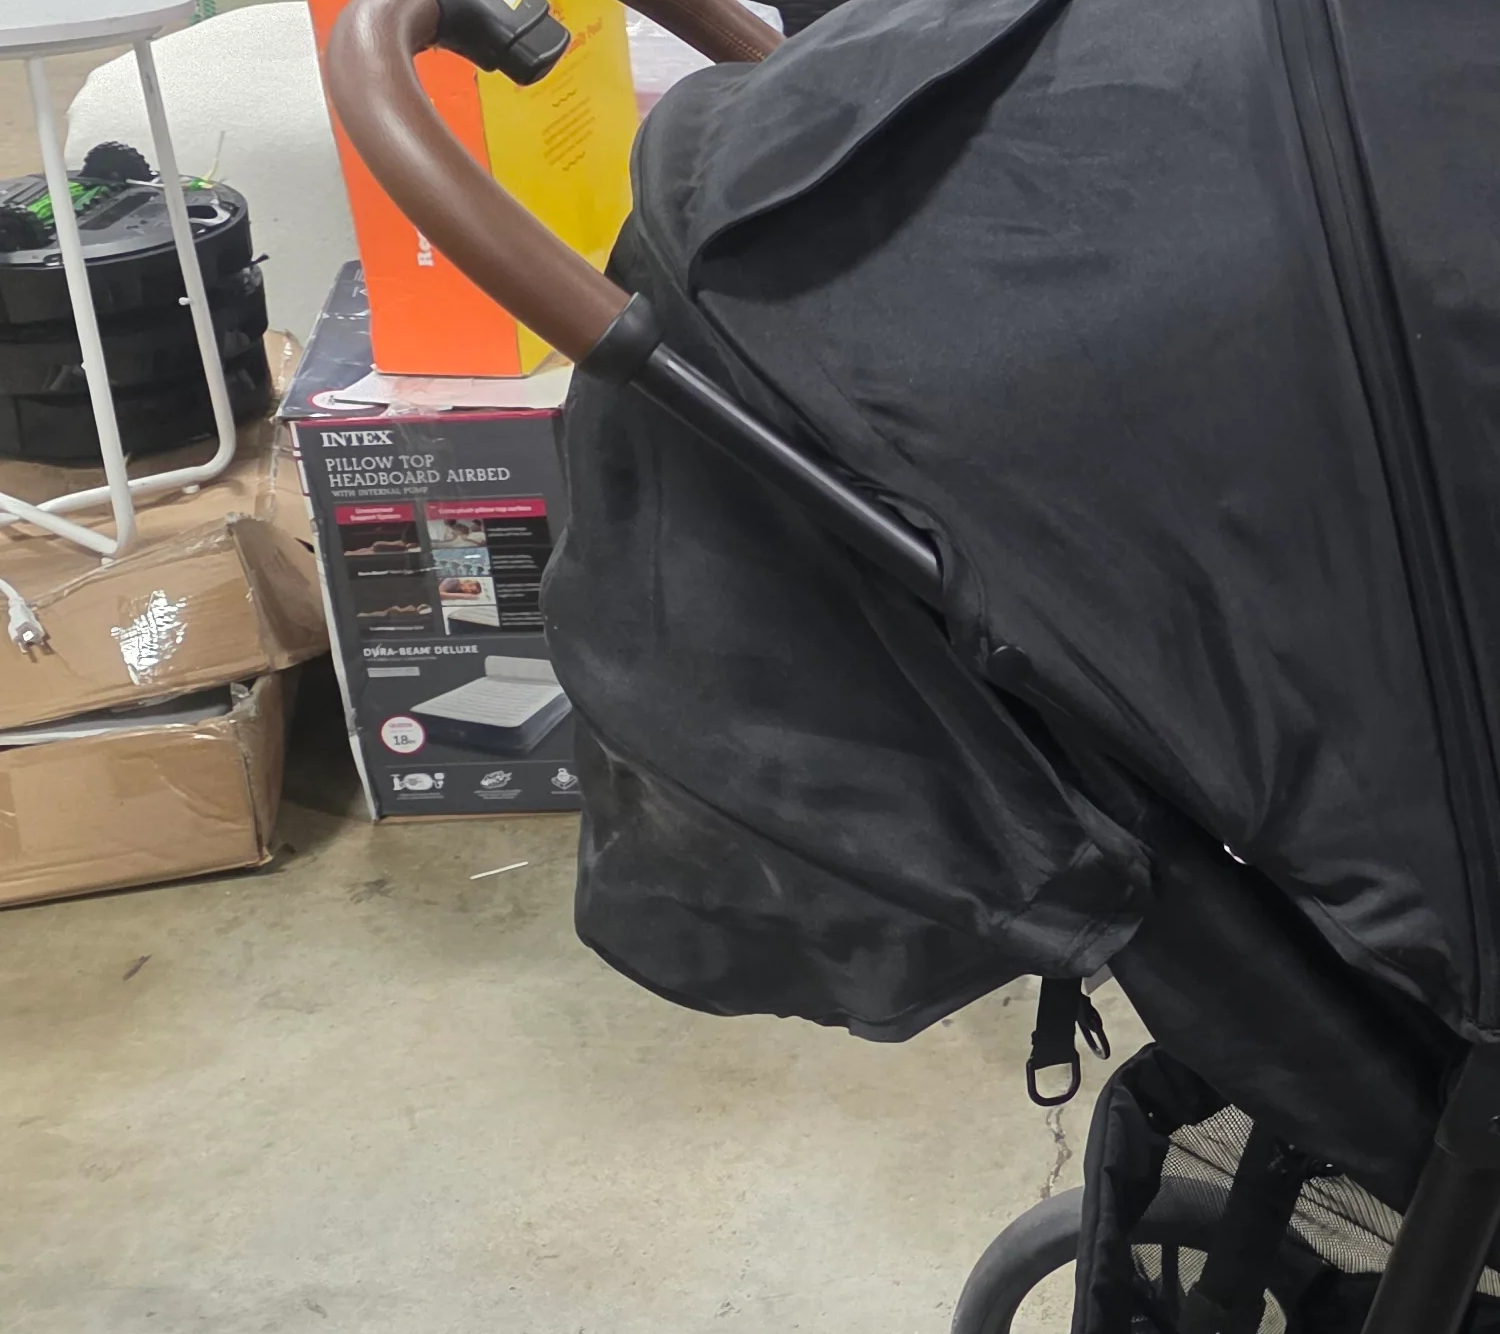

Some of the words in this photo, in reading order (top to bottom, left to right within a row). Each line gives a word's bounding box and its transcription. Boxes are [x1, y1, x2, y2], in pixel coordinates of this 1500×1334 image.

[320, 430, 394, 447] INTEX
[325, 456, 394, 471] PILLOW
[399, 454, 435, 469] TOP
[328, 470, 441, 488] HEADBOARD
[446, 467, 512, 484] AIRBED
[434, 645, 479, 654] DELUXE
